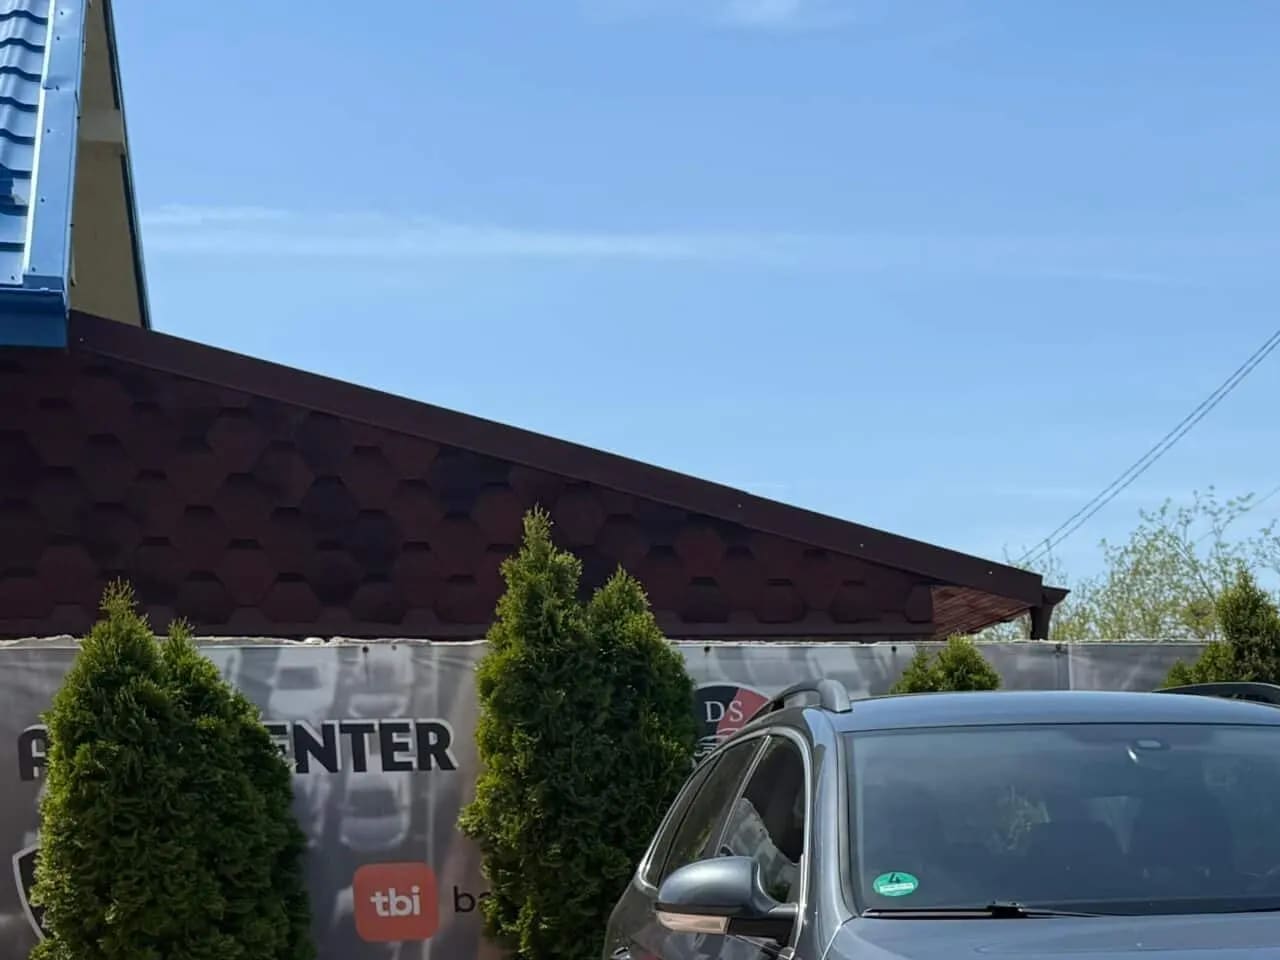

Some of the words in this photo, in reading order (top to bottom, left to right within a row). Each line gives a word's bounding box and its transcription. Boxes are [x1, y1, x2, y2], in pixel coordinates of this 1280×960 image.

[704, 700, 743, 722] DS
[265, 721, 457, 774] NTER
[370, 886, 420, 917] tbi
